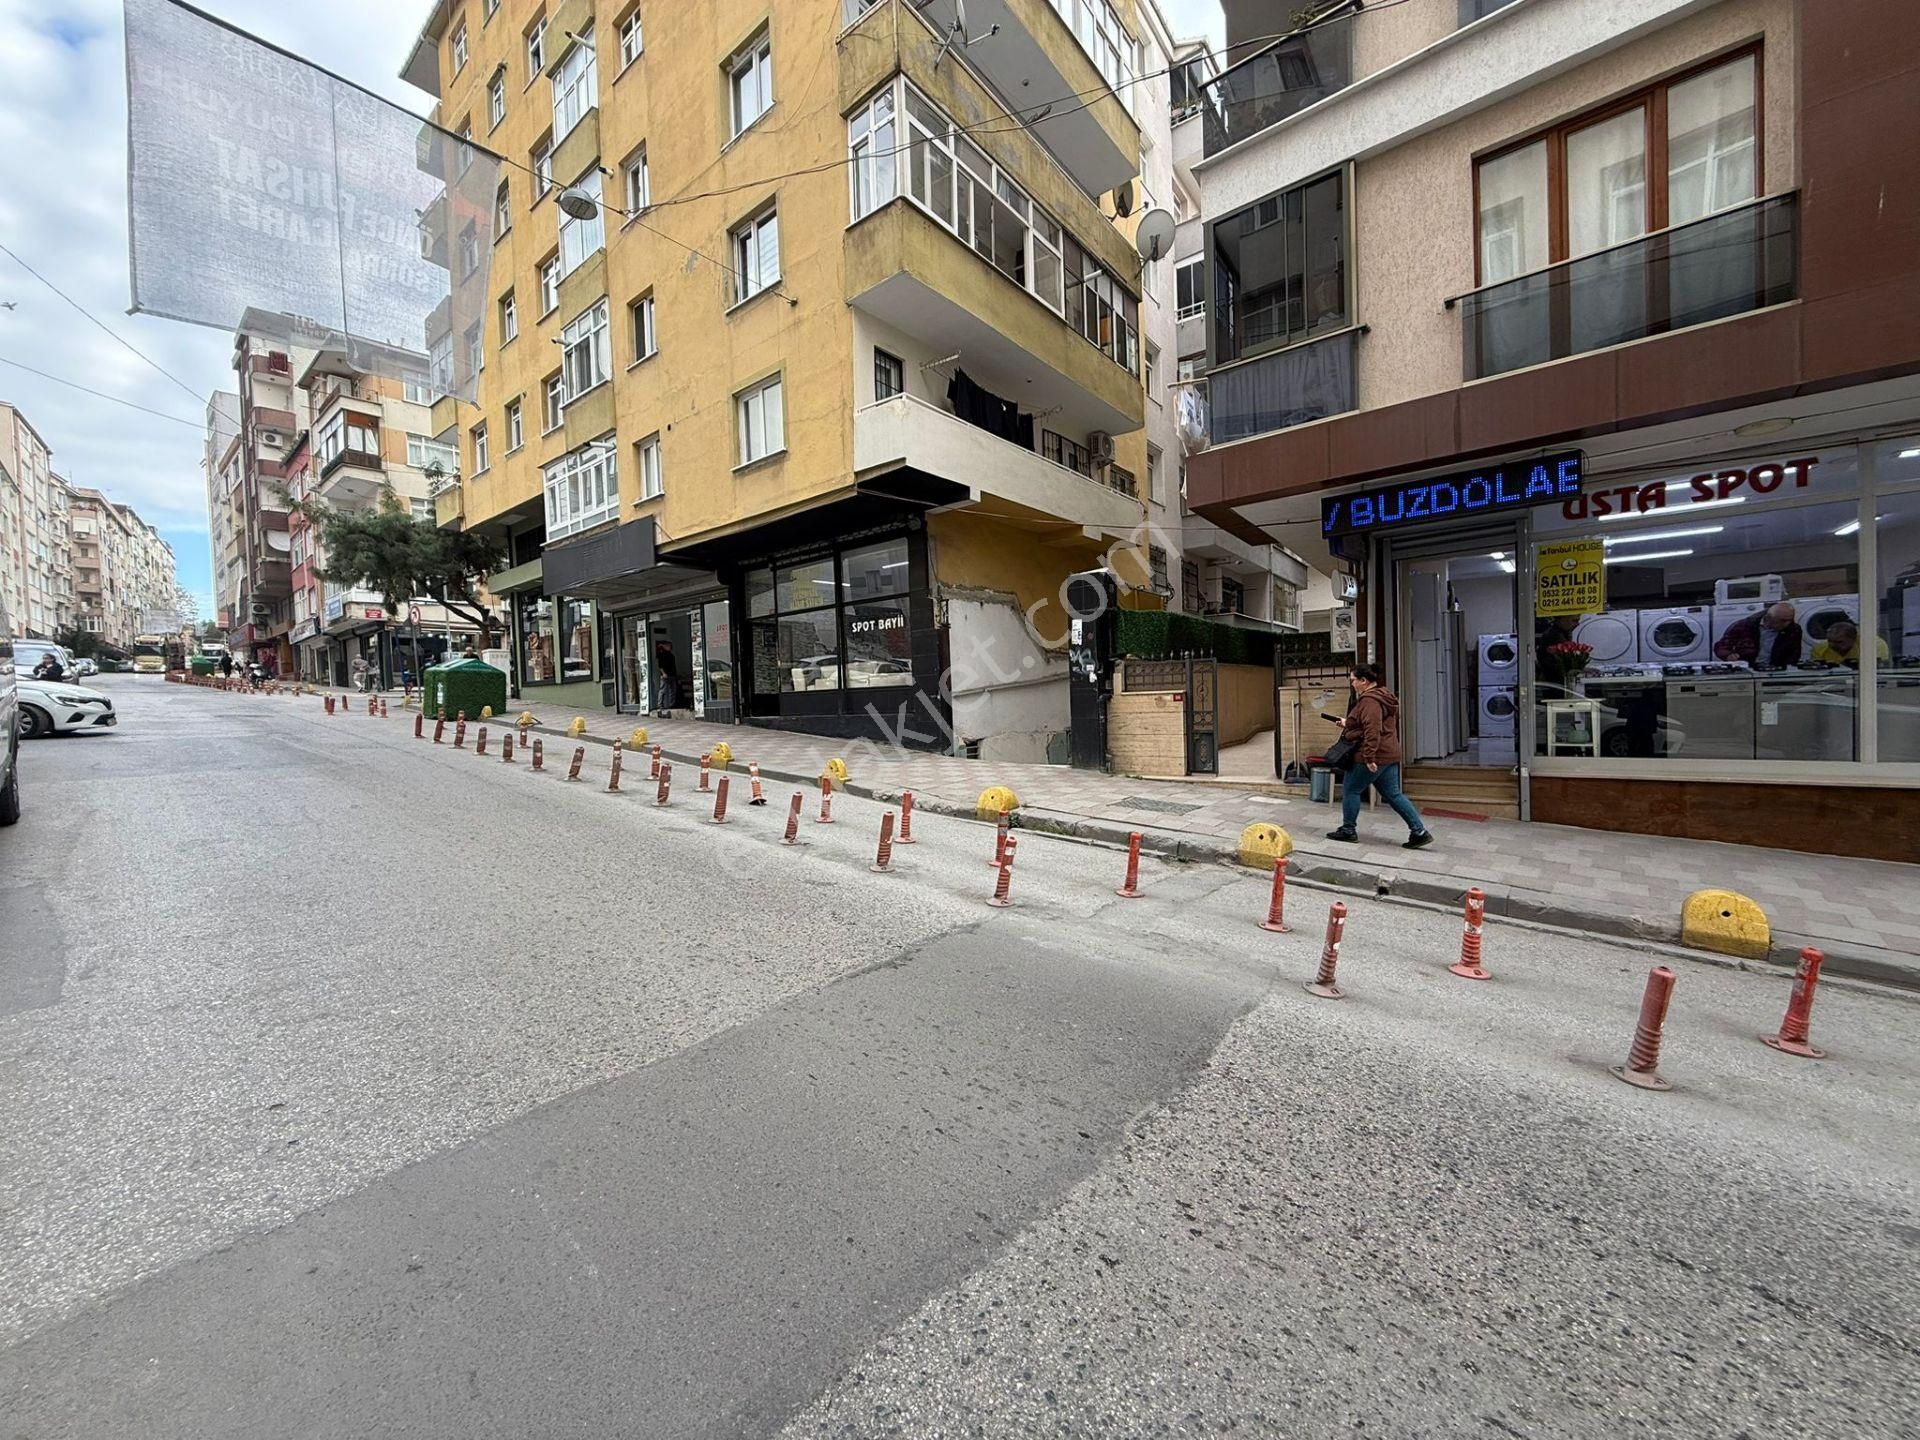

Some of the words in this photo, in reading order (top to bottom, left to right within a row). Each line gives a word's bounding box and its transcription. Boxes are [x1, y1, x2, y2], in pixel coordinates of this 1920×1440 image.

[1562, 481, 1666, 521] USTA
[1689, 457, 1819, 503] SPOT
[1573, 542, 1602, 553] HOUSE
[1541, 571, 1599, 588] SATILIK
[1542, 598, 1560, 607] 0212
[1587, 595, 1597, 604] 22
[851, 620, 876, 633] SPOT
